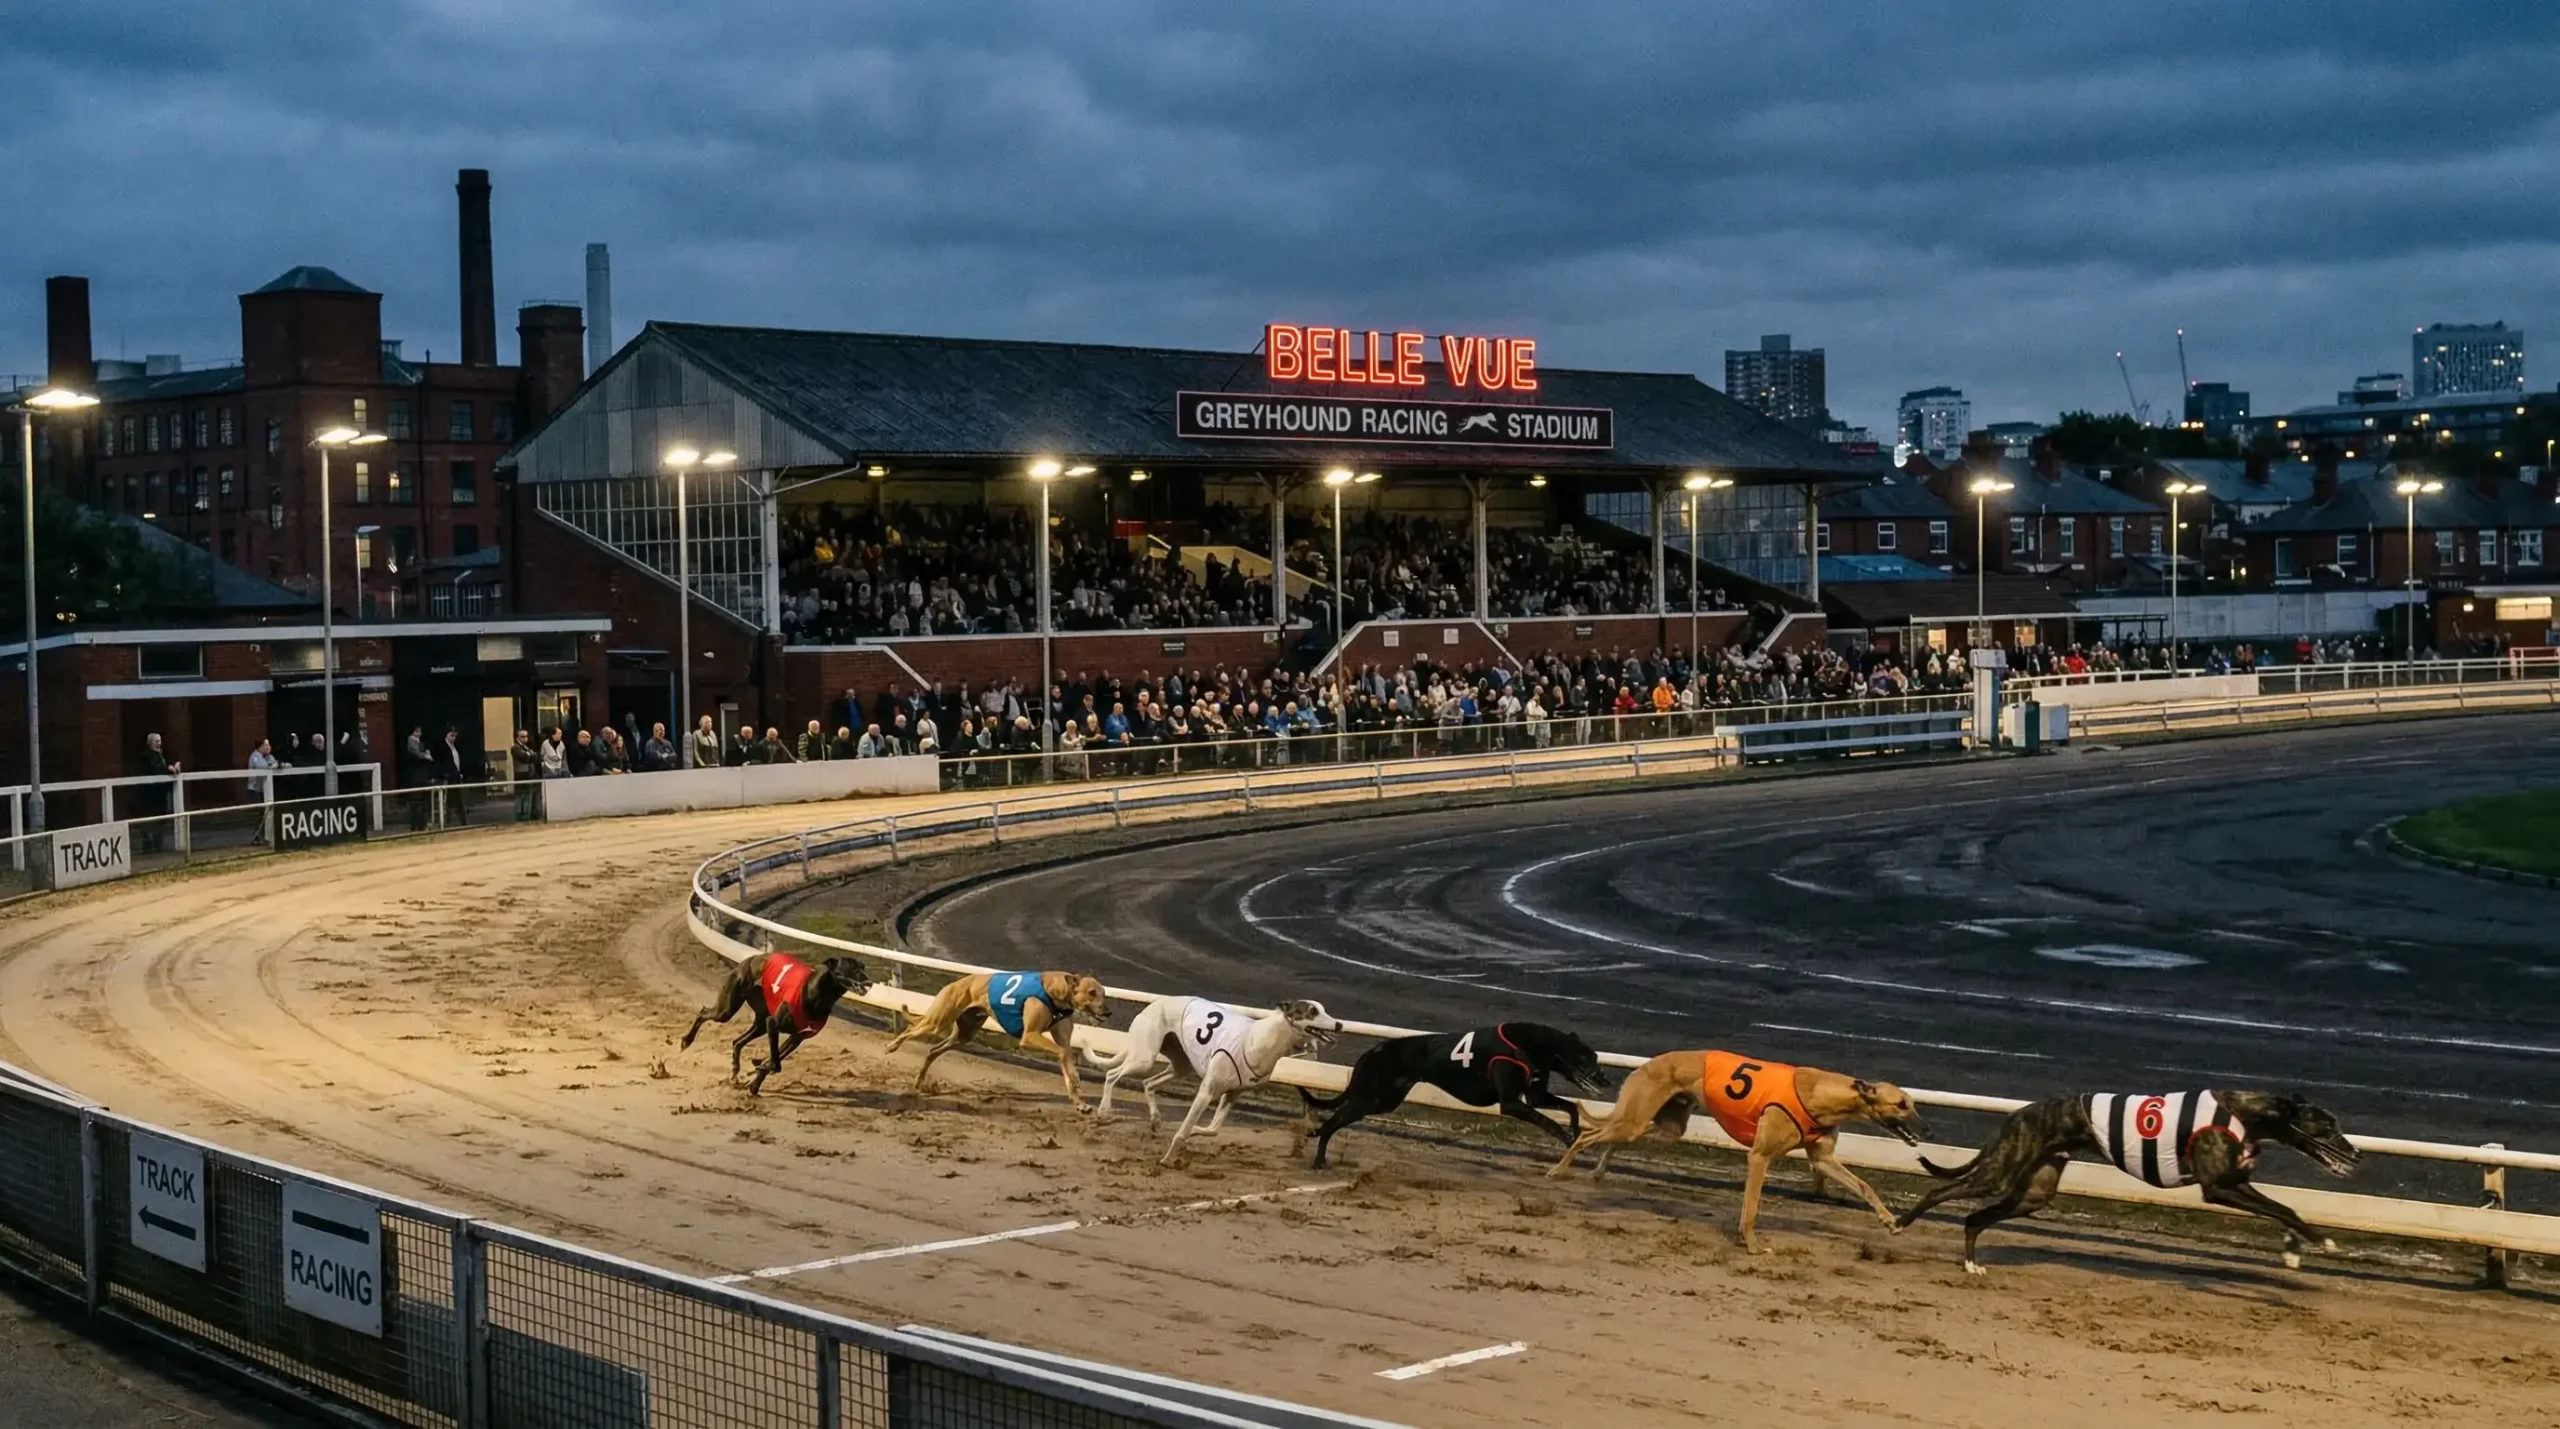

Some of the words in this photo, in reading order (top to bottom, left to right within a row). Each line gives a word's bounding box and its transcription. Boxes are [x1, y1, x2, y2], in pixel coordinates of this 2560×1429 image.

[1267, 325, 1425, 385] BELLE
[1444, 335, 1538, 390] VUE
[1195, 401, 1351, 432] GREYHOUND
[1362, 408, 1448, 435] RACING
[1507, 413, 1599, 440] STADIUM
[281, 805, 358, 841] RACING
[60, 835, 123, 873] TRACK
[771, 963, 794, 994] 1
[1000, 974, 1023, 1006] 2
[1195, 1011, 1224, 1046] 3
[1450, 1031, 1476, 1068] 4
[1724, 1062, 1763, 1101] 5
[2135, 1096, 2166, 1140] 6
[136, 1154, 196, 1204] TRACK
[291, 1248, 373, 1306] RACING
